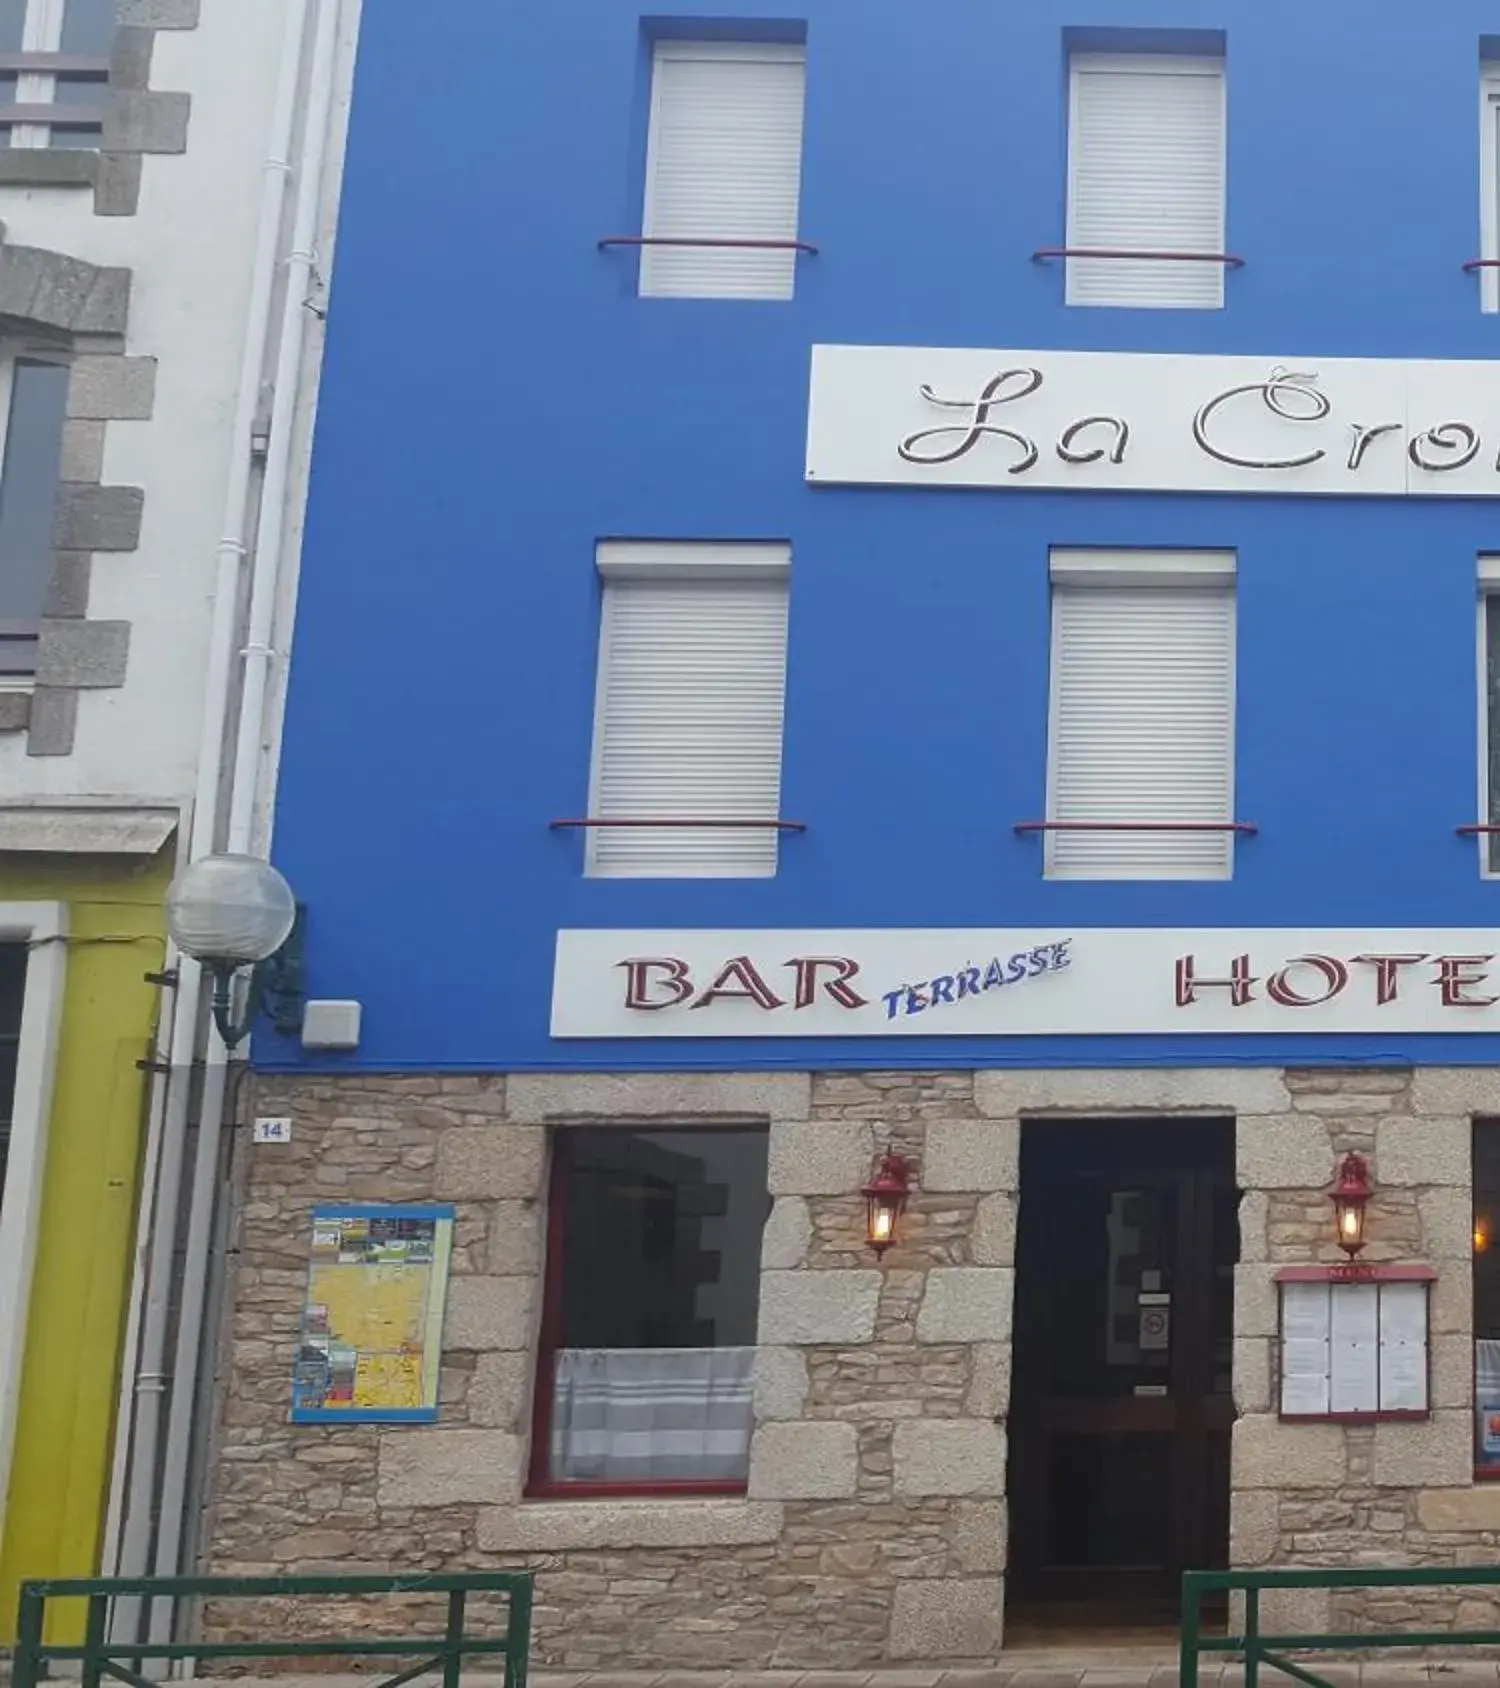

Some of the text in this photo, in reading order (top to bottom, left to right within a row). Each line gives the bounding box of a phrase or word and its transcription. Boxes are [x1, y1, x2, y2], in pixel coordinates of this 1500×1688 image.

[899, 367, 1129, 474] La
[615, 955, 870, 1011] BAR
[881, 937, 1074, 1020] TERRASSE
[261, 1122, 281, 1138] 14
